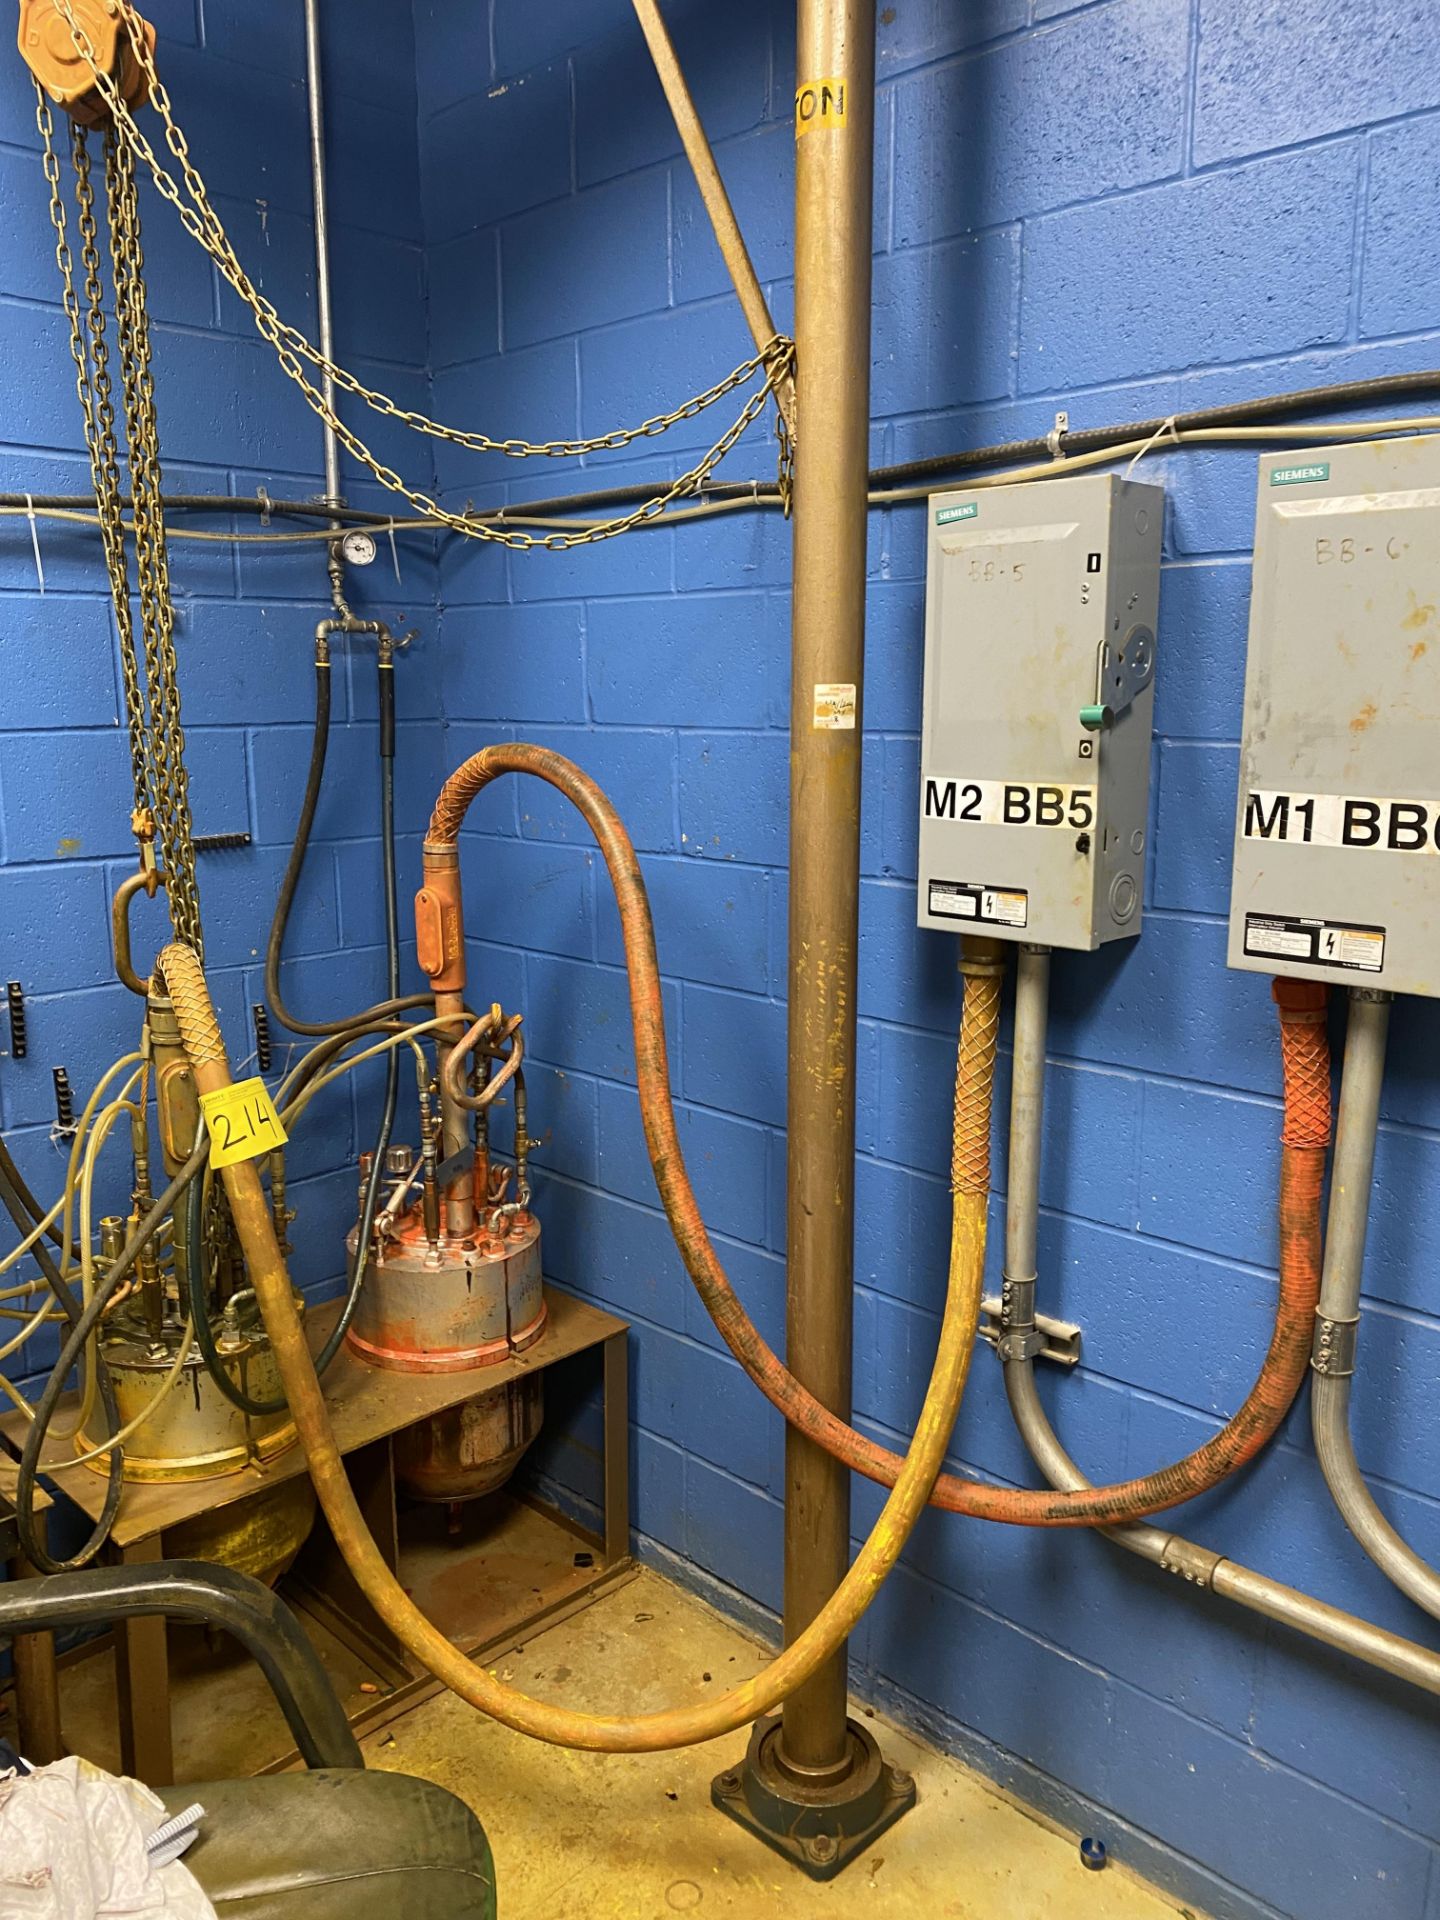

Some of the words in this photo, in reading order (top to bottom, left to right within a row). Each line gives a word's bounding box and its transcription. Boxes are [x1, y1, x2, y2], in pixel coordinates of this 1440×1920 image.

[795, 85, 844, 121] ON
[1274, 466, 1324, 481] SIEMENS
[938, 505, 974, 520] SIEMENS
[925, 780, 983, 821] M2
[1003, 785, 1093, 829] BB5
[1244, 794, 1315, 842] M1
[1342, 800, 1440, 851] BB
[213, 1096, 279, 1151] 214
